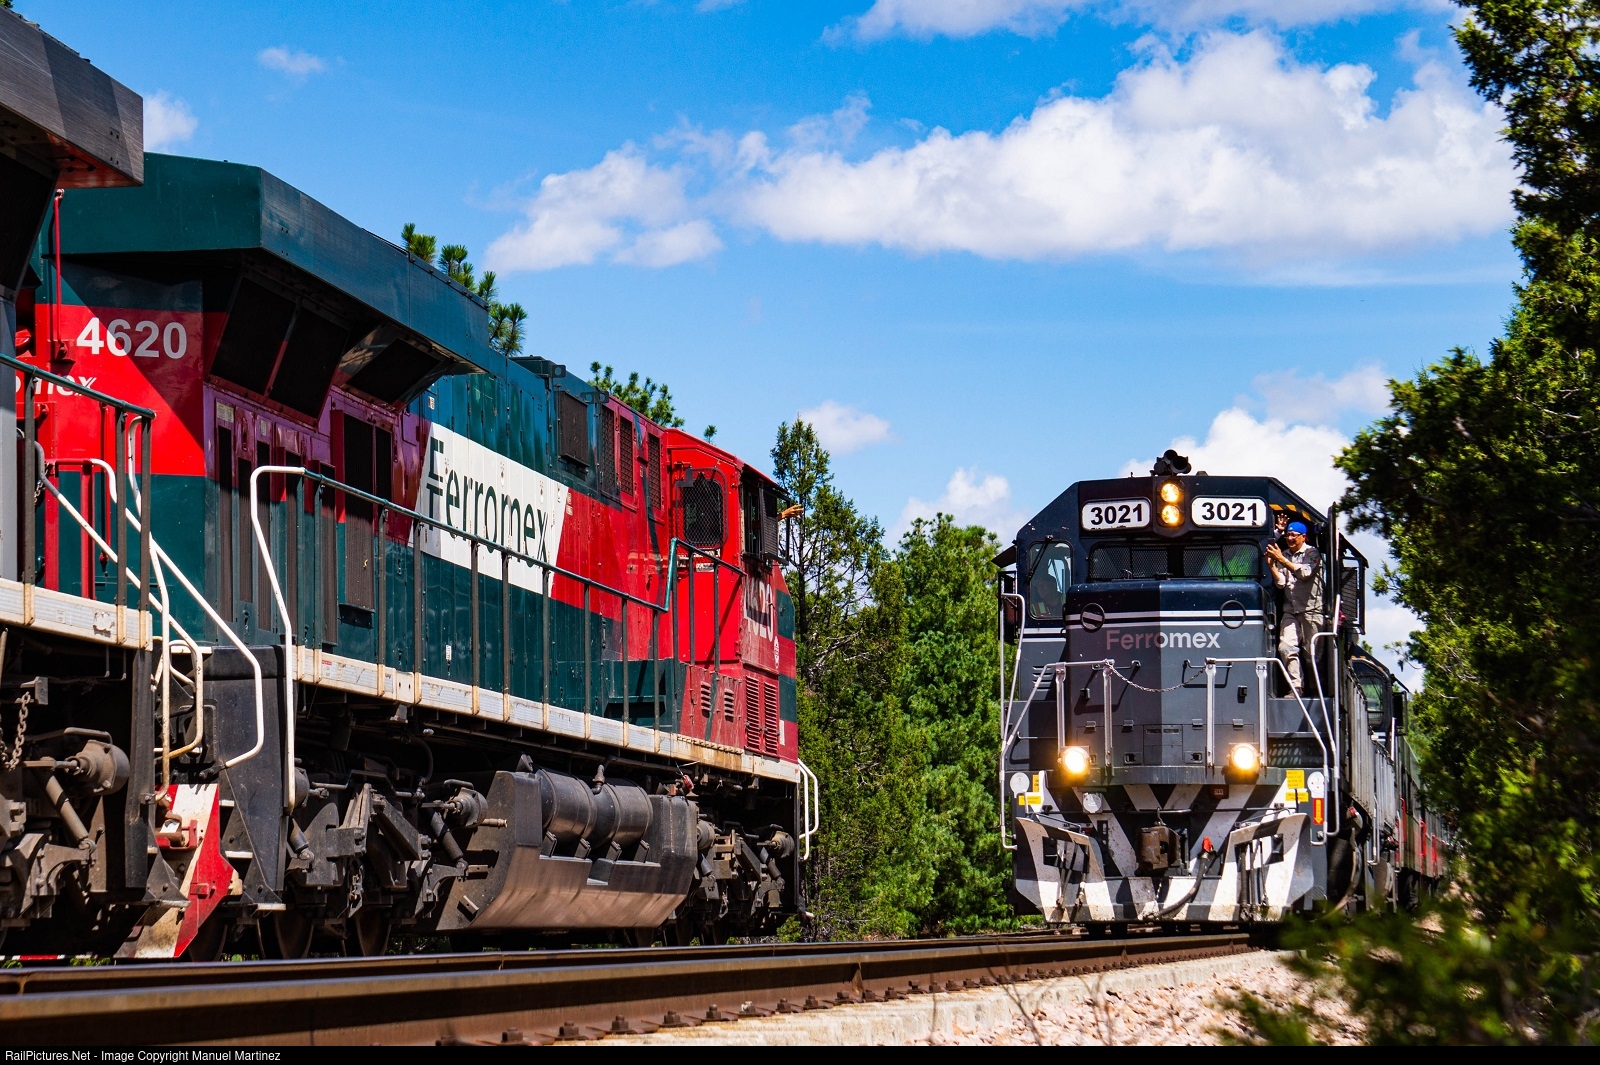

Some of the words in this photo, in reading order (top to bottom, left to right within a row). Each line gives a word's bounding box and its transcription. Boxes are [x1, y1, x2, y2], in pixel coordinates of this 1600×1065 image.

[76, 317, 188, 360] 4620
[425, 436, 549, 568] Ferromex
[1201, 501, 1258, 522] 3021
[1090, 503, 1143, 526] 3021
[1106, 629, 1221, 651] Ferromex
